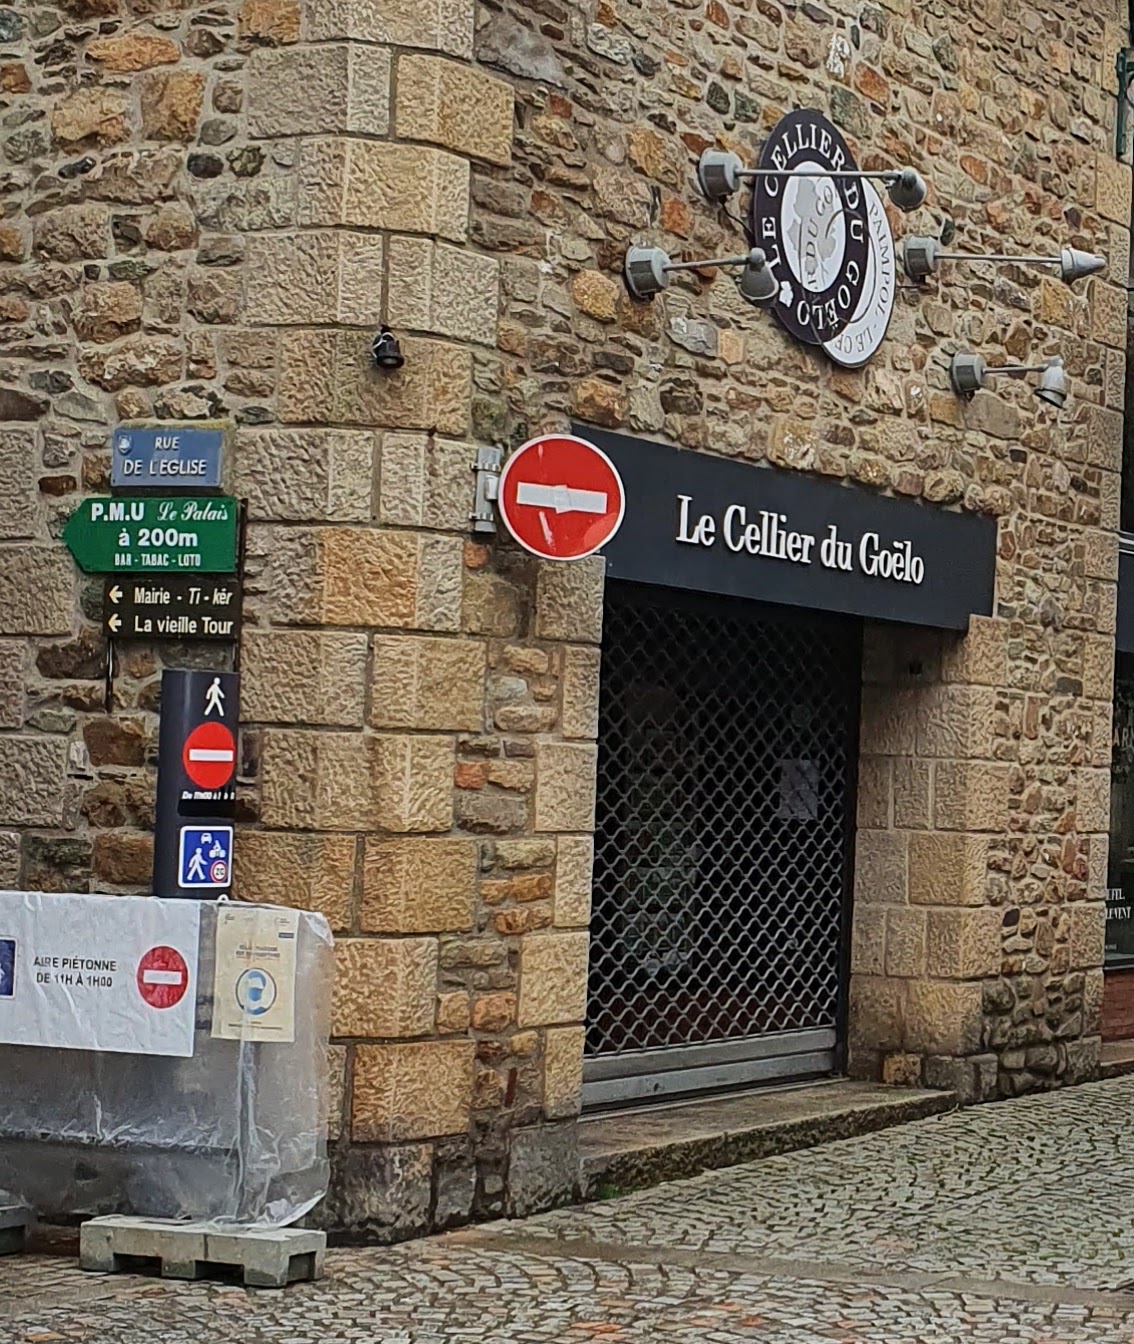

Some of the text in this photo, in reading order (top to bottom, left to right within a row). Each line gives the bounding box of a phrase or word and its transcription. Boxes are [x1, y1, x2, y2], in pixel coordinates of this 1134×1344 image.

[764, 122, 846, 198] CELLIER
[844, 178, 864, 244] DU
[762, 216, 782, 275] LE
[869, 202, 891, 317] PAIMPOL
[155, 436, 180, 450] RUE
[123, 459, 143, 475] DE
[91, 500, 229, 521] P.M.U Le Palais
[118, 528, 198, 547] à 200m
[676, 494, 924, 585] Le Cellier du Goëlo
[114, 553, 132, 567] BAR
[141, 553, 169, 567] TABAC
[178, 553, 201, 567] LOTO
[134, 587, 171, 604] Mairie
[188, 587, 202, 605] Ti
[134, 615, 234, 635] La vieille Tour
[33, 955, 117, 972] AIRE PIÉTONNE
[36, 971, 113, 988] DE 11H À 1H00
